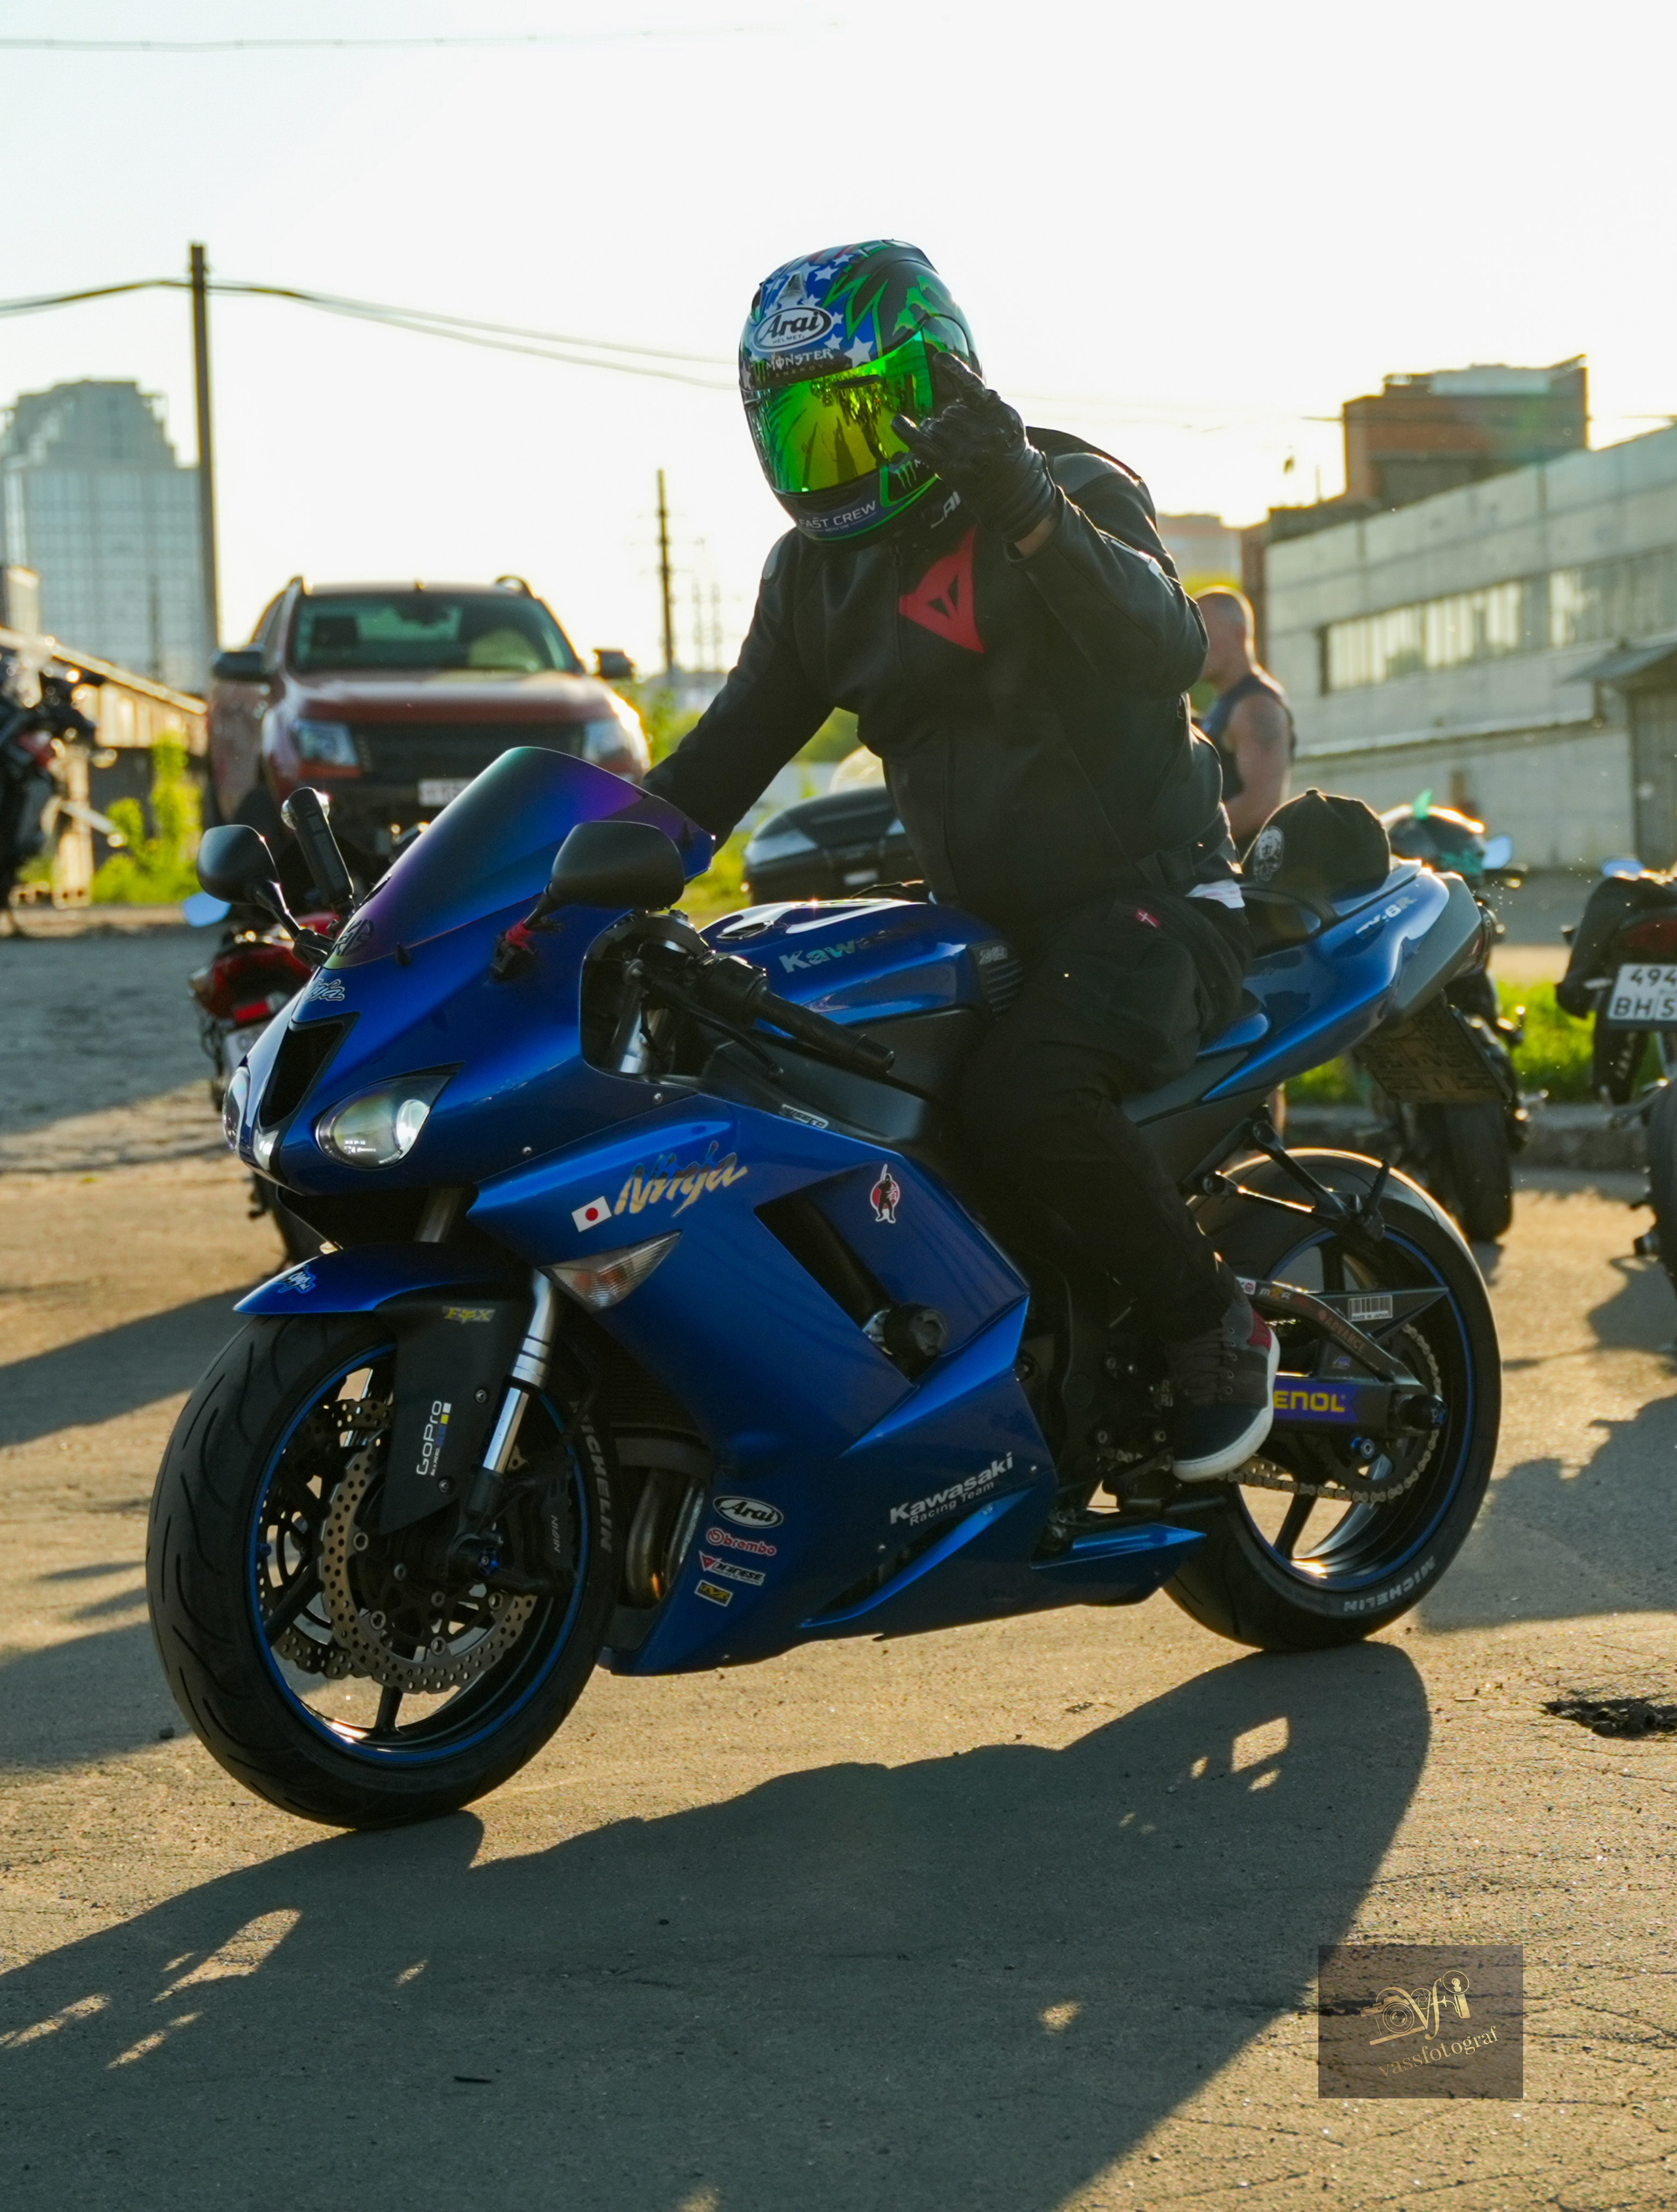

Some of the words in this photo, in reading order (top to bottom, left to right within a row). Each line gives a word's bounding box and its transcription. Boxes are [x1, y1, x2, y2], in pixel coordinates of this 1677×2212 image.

[759, 310, 820, 342] Arai
[766, 348, 834, 371] MONSTER
[799, 517, 829, 528] FAST
[833, 500, 875, 525] CREW
[614, 1140, 748, 1218] Ninja
[416, 1400, 442, 1475] GoPro
[890, 1452, 1013, 1525] Kawasaki
[910, 1499, 956, 1526] Racing
[960, 1481, 994, 1503] Team
[719, 1501, 776, 1522] Arai
[723, 1533, 777, 1556] brembo
[1344, 1556, 1435, 1612] MICHELIN
